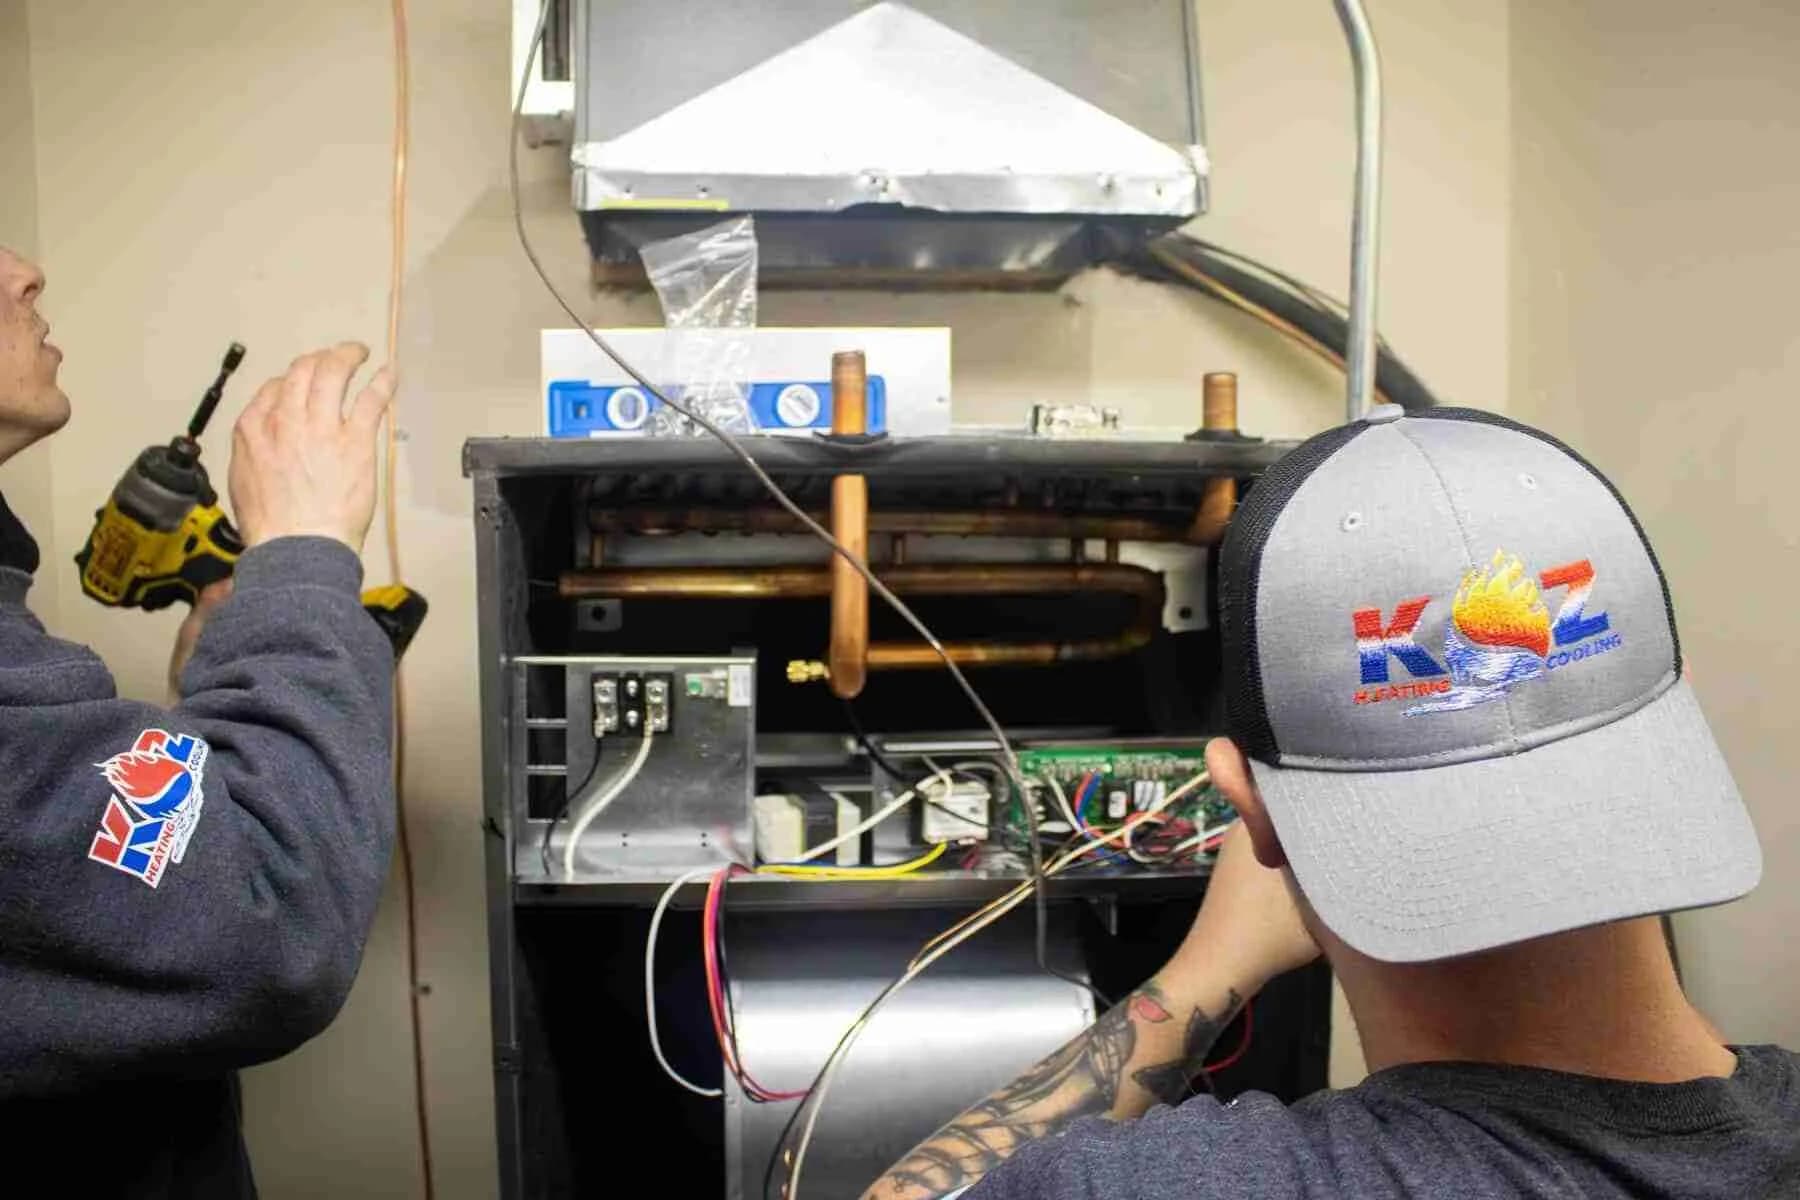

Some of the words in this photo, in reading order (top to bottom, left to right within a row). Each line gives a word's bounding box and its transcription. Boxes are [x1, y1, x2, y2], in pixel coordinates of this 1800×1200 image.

[1546, 633, 1622, 669] COOLING
[1353, 679, 1452, 704] HEATING
[145, 821, 176, 883] HEATING
